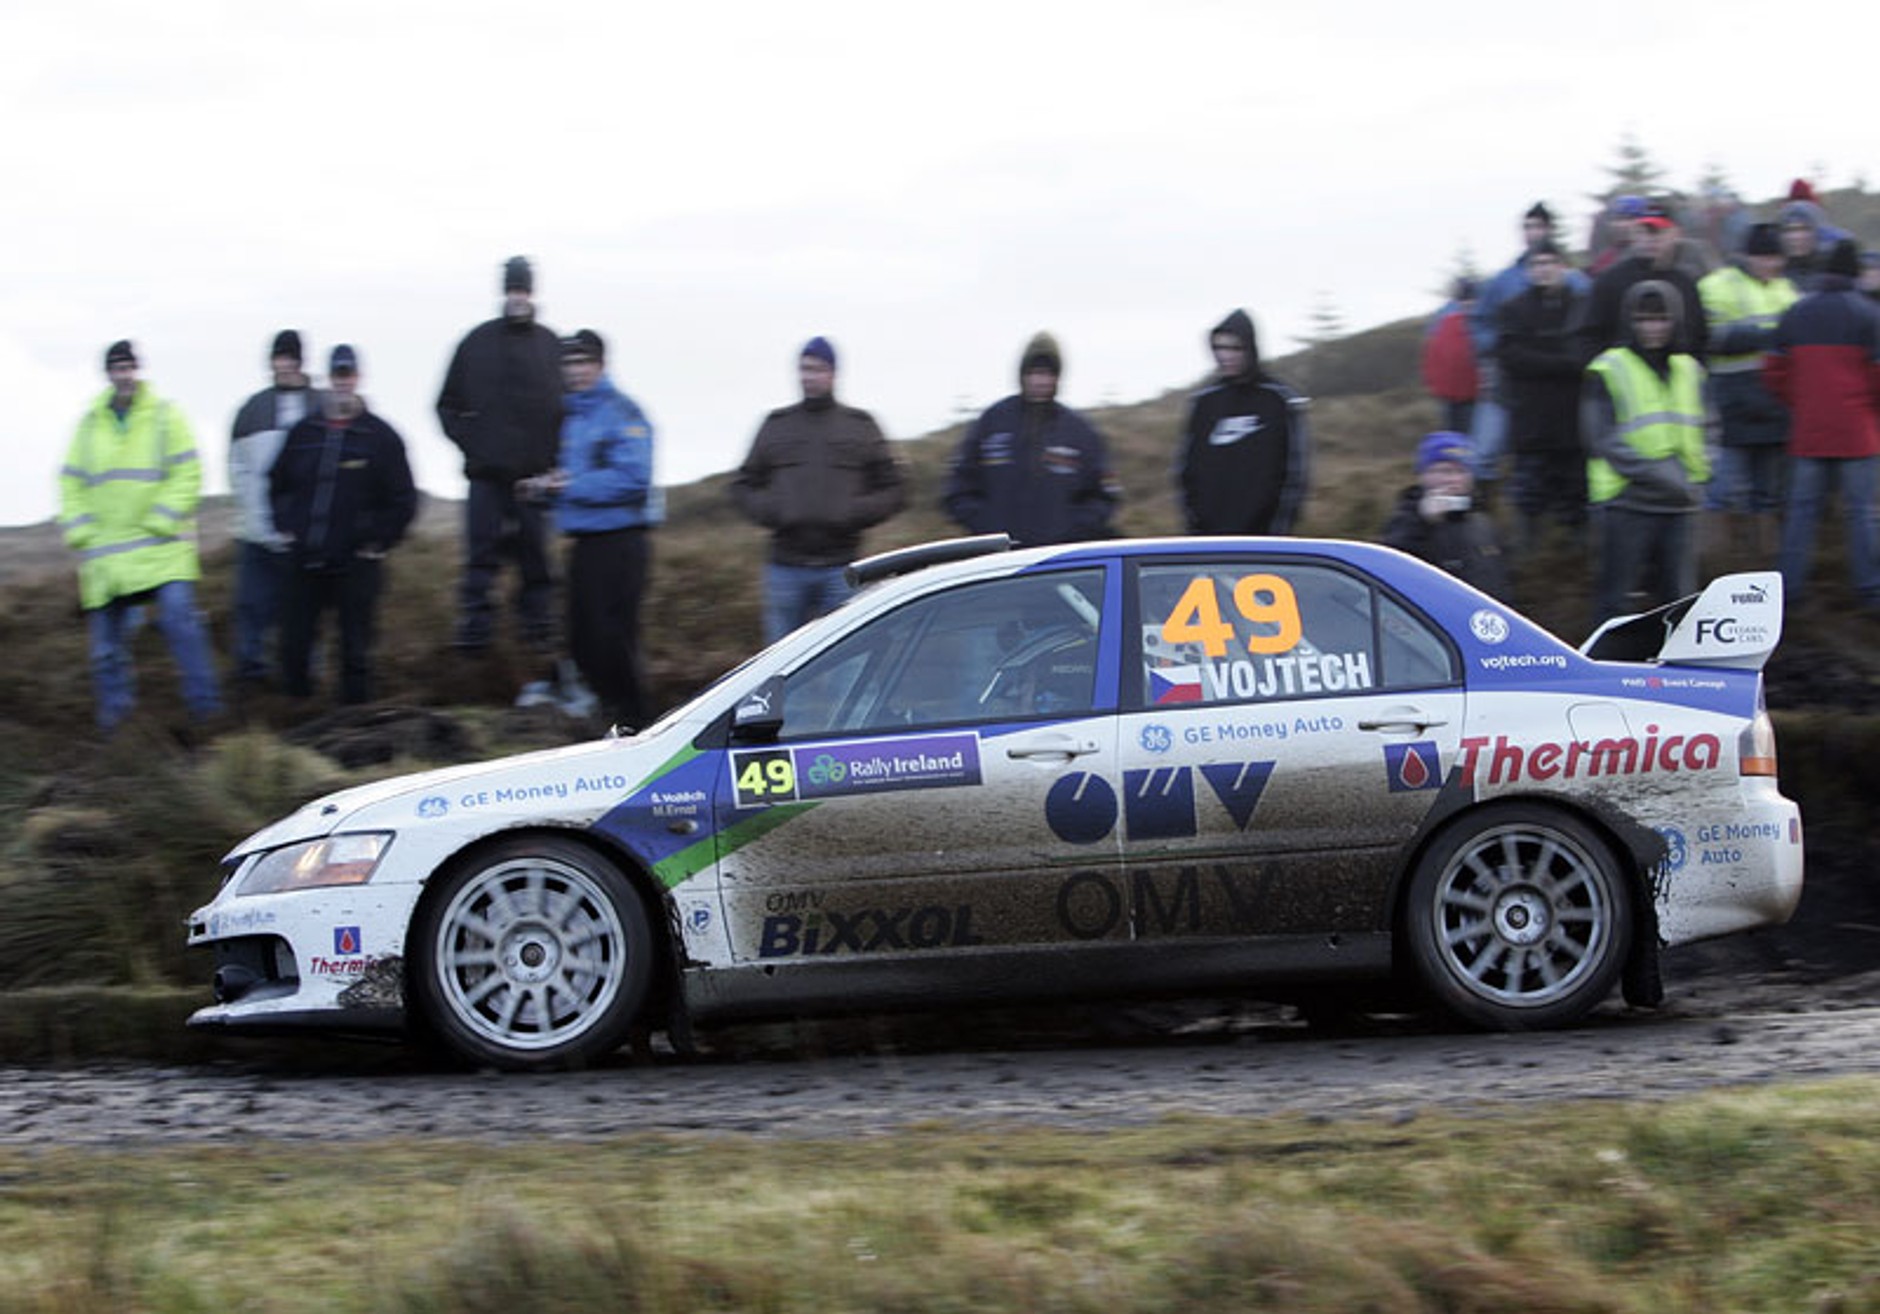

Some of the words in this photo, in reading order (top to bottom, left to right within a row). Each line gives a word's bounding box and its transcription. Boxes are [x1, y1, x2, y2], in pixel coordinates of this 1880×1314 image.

[1161, 573, 1303, 657] 49
[1696, 617, 1737, 645] FC
[1205, 646, 1372, 700] VOJTĚCH
[1480, 654, 1567, 671] vojtech.org
[1183, 726, 1212, 744] GE
[1217, 721, 1288, 740] Money
[1293, 715, 1344, 733] Auto
[849, 760, 893, 777] Rally
[894, 751, 964, 774] Ireland
[1458, 723, 1722, 789] Thermica
[460, 792, 490, 808] GE
[495, 783, 568, 803] Money
[574, 773, 627, 793] Auto
[737, 758, 795, 796] 49
[1697, 825, 1722, 843] GE
[1726, 822, 1781, 841] Money
[1701, 849, 1742, 865] Auto
[766, 890, 825, 912] OMV
